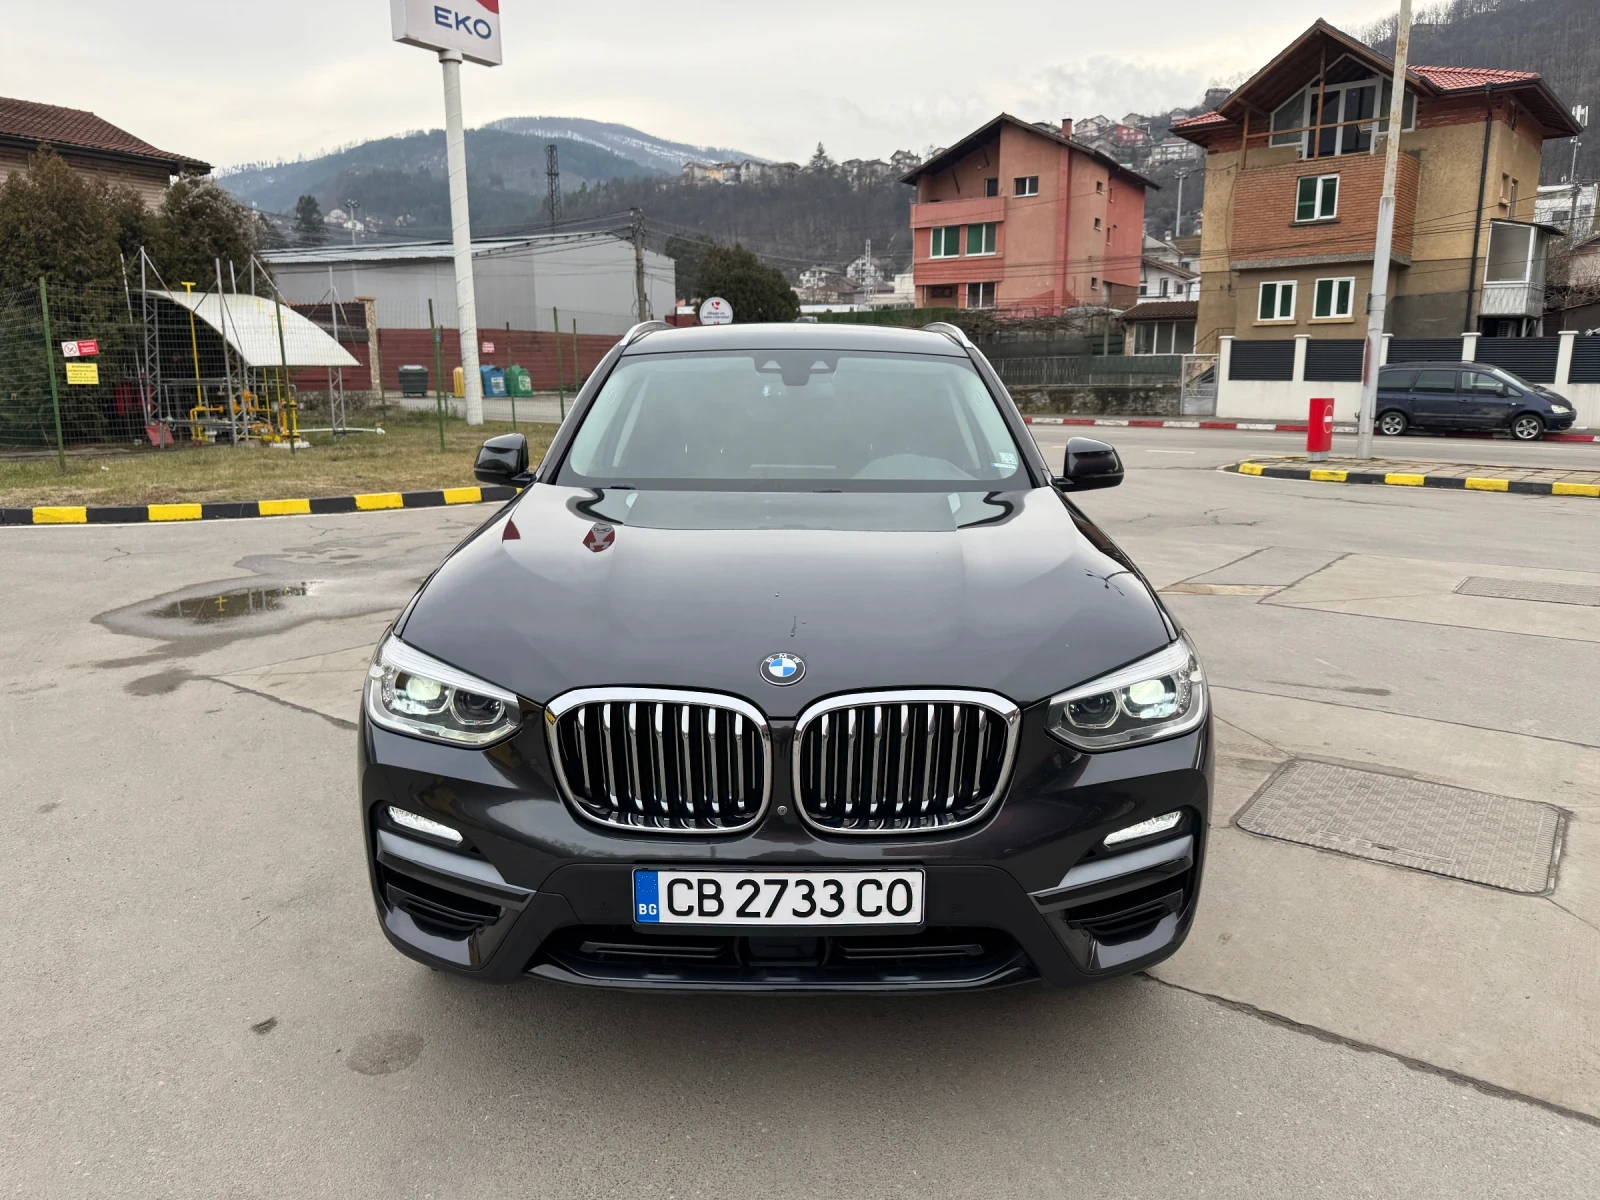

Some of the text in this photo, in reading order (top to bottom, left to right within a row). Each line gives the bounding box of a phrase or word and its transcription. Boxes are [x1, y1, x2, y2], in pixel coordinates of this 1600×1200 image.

[434, 5, 492, 40] EKO
[765, 653, 802, 663] BMW
[638, 903, 657, 916] BG
[667, 878, 724, 917] CB
[735, 878, 845, 918] 2733
